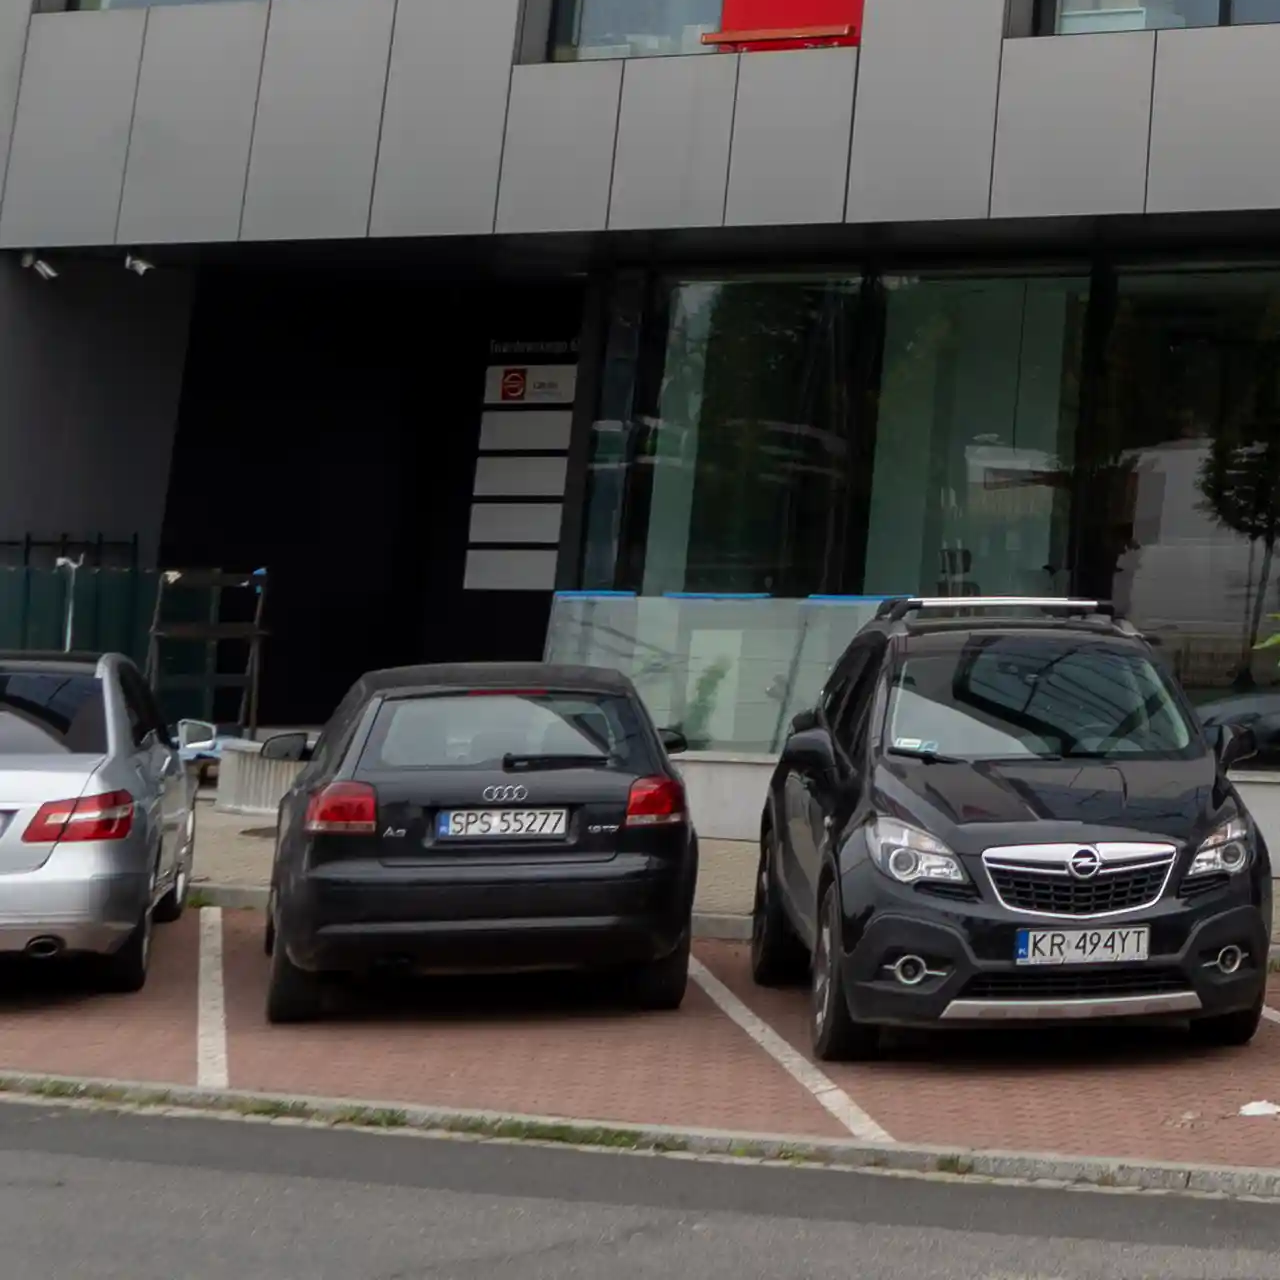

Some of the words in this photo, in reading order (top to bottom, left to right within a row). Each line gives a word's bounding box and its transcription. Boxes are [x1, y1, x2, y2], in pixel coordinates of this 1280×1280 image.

[452, 812, 492, 834] SPS
[500, 811, 563, 833] 55277
[1032, 934, 1065, 956] KR
[1074, 930, 1145, 955] 494YT
